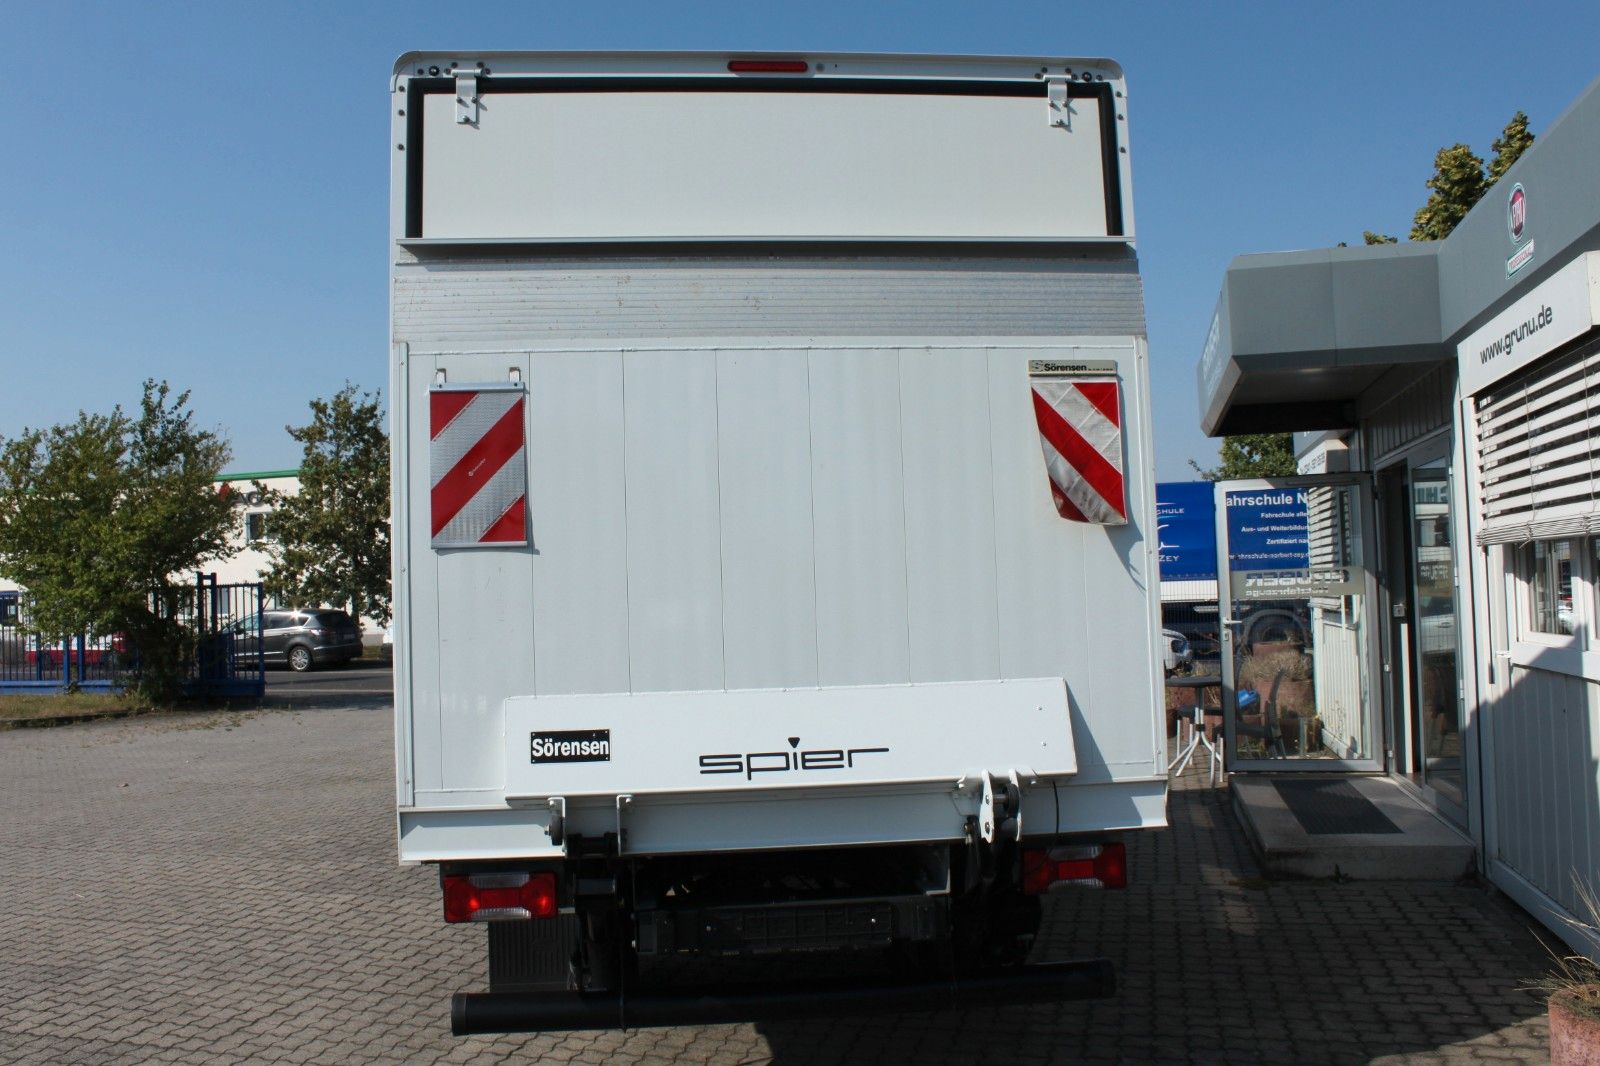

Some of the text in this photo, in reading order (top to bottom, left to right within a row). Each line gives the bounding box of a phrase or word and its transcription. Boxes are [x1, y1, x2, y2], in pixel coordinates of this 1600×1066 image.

[1480, 304, 1553, 366] www.grunu.de
[1044, 363, 1087, 372] Sörensen
[532, 738, 609, 757] Sörensen
[700, 737, 889, 781] spier
